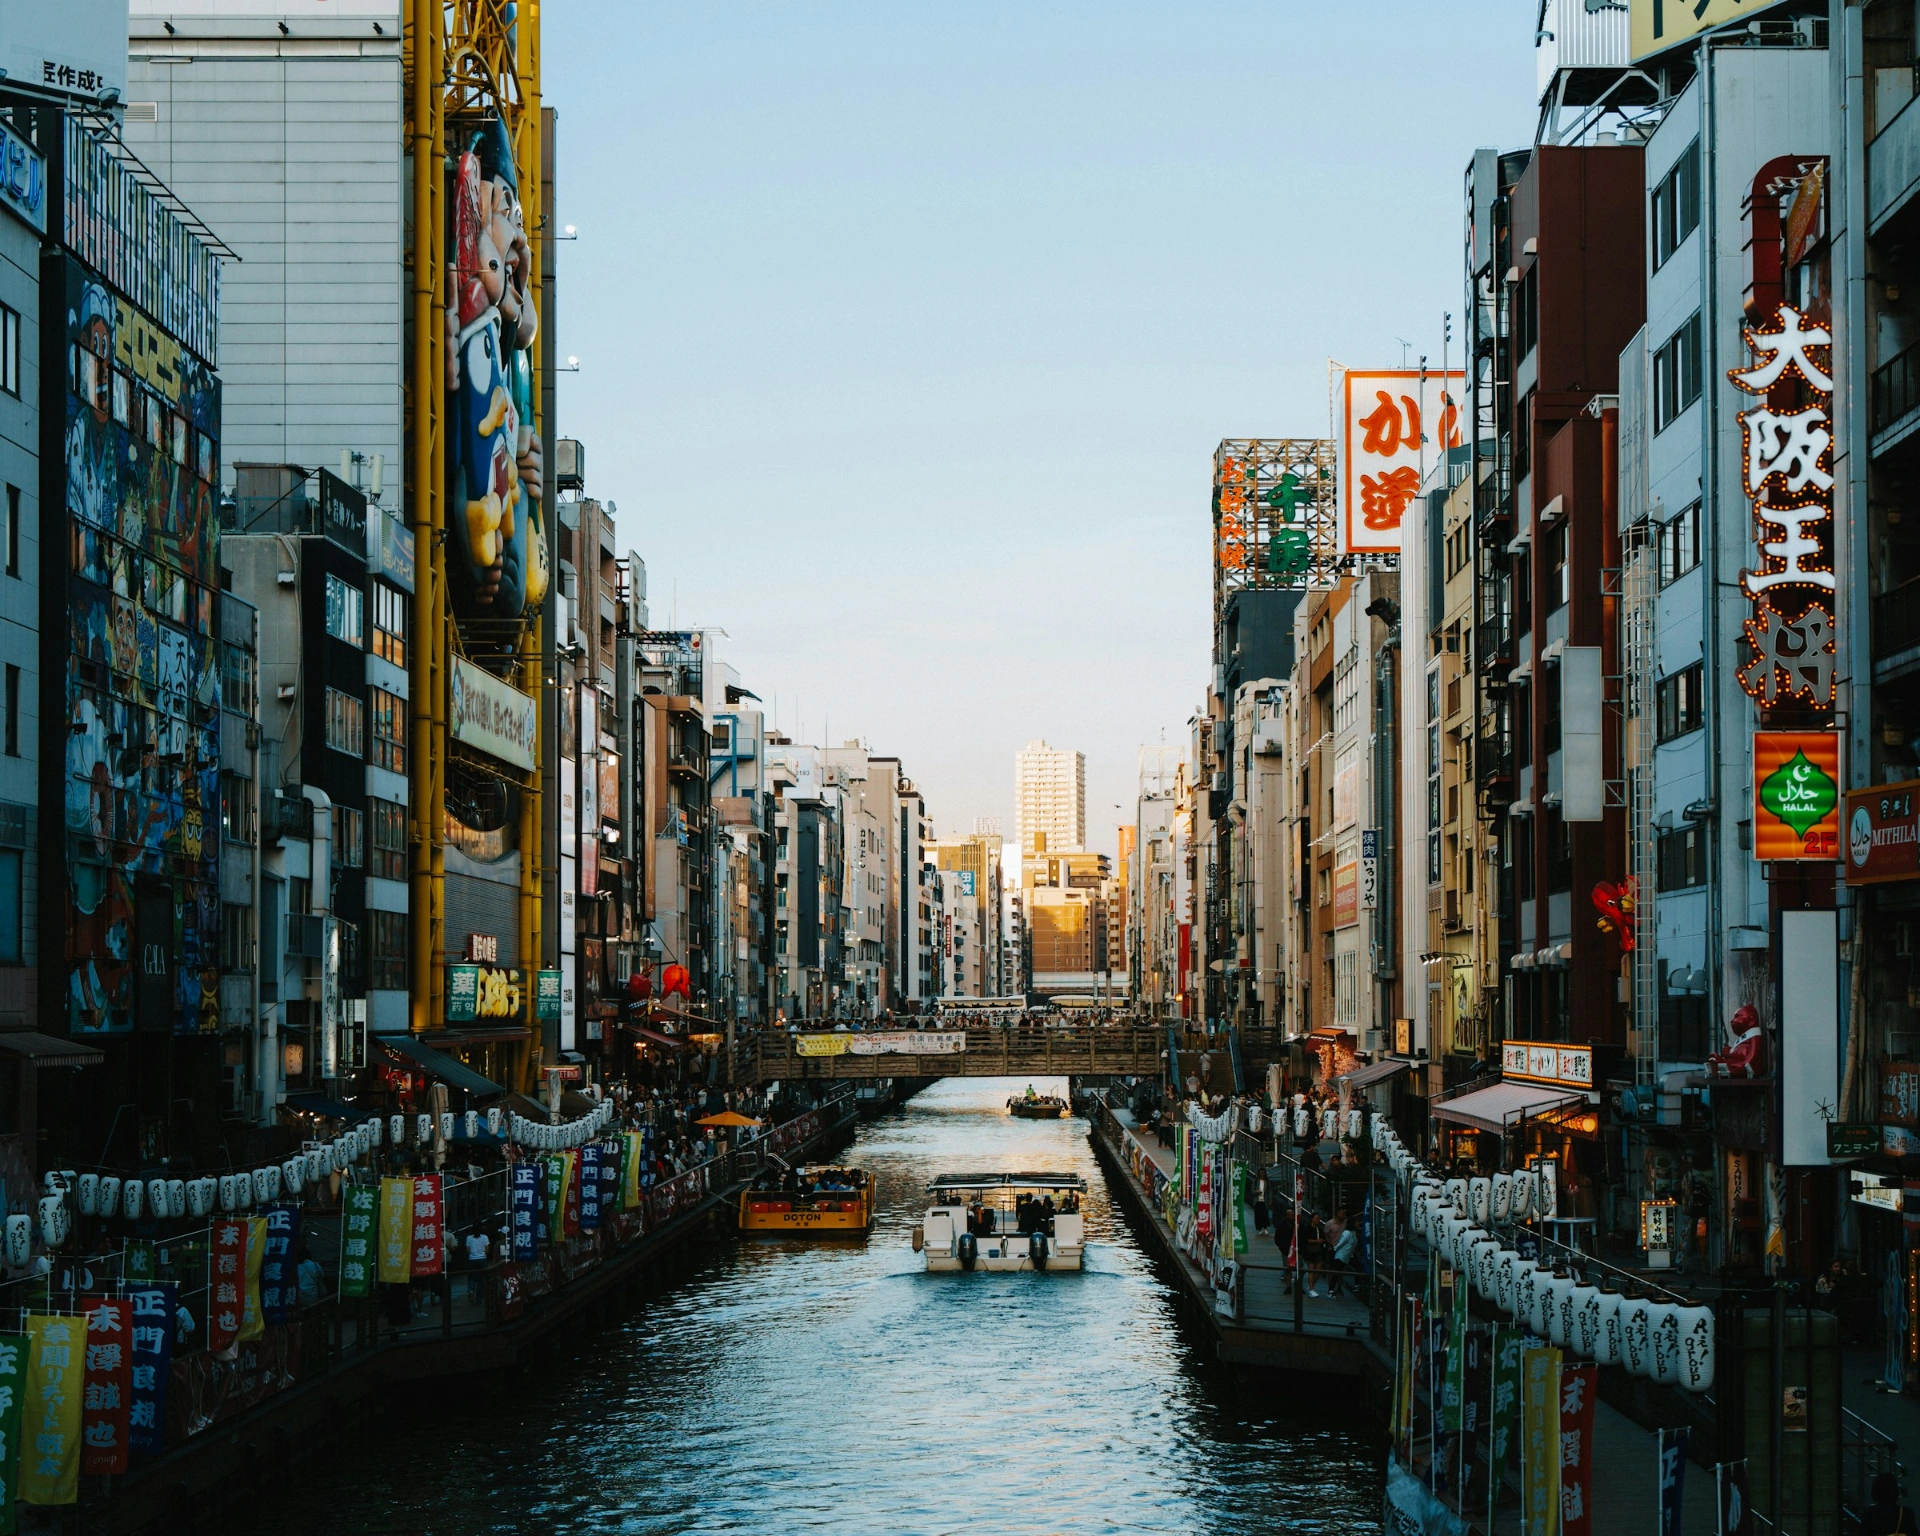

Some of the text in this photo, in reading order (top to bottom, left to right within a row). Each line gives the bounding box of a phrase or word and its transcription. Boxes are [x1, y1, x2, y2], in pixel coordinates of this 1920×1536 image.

[116, 300, 182, 405] 2025
[1219, 456, 1247, 569] お好み焼
[1731, 303, 1836, 706] 大阪王将
[1778, 779, 1819, 802] حلال
[1804, 832, 1837, 854] 2F
[1872, 824, 1917, 847] MITHILA
[1363, 833, 1376, 906] 焼肉 いろりや
[143, 943, 166, 975] GALA
[453, 972, 475, 994] 薬
[539, 977, 559, 997] 薬
[1734, 1160, 1742, 1201] SAMURA
[1478, 1261, 1488, 1295] group
[1495, 1270, 1506, 1306] group
[1515, 1282, 1524, 1319] group
[1560, 1303, 1571, 1342] group
[1579, 1311, 1591, 1352] group
[1606, 1319, 1617, 1361] group
[1625, 1326, 1640, 1370] group
[1653, 1331, 1667, 1378] group
[1685, 1337, 1700, 1386] group
